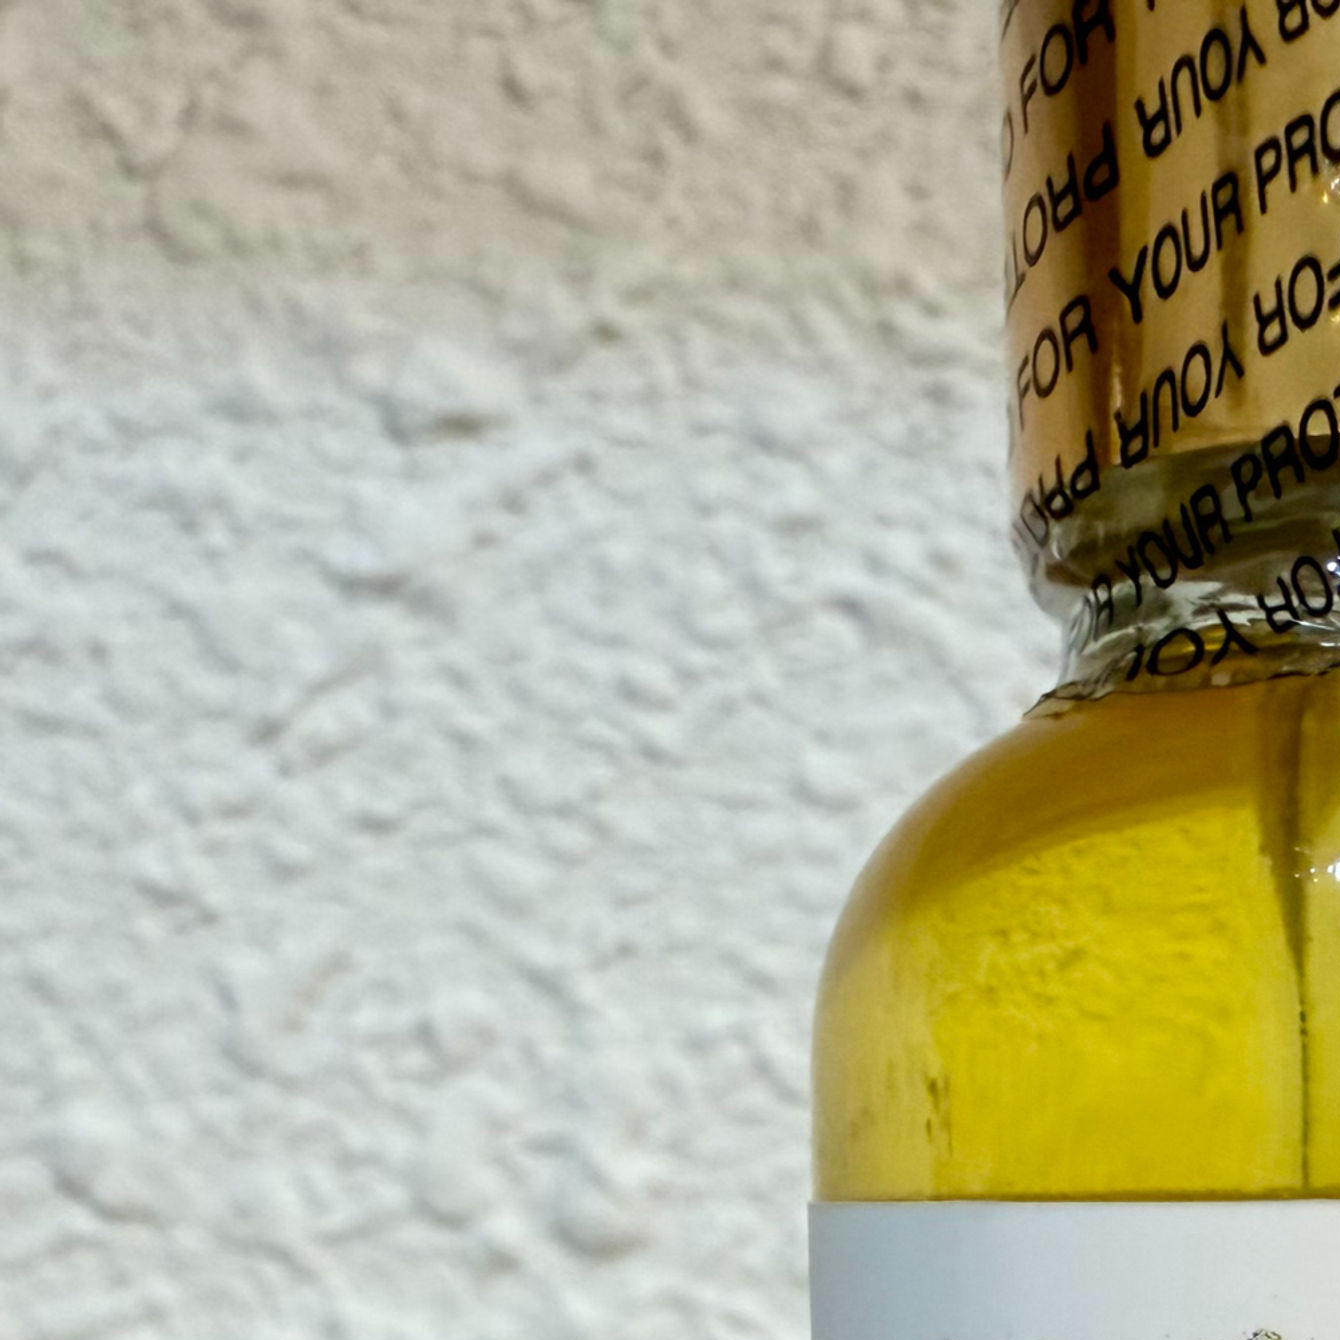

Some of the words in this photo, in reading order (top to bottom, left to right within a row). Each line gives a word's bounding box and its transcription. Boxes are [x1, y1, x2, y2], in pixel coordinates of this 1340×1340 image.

[1019, 0, 1117, 136] FOR
[1133, 2, 1267, 159] YOUR
[1016, 294, 1098, 432] FOR
[1107, 170, 1244, 324] YOUR
[1113, 318, 1245, 469] YOUR
[1113, 483, 1233, 608] YOUR
